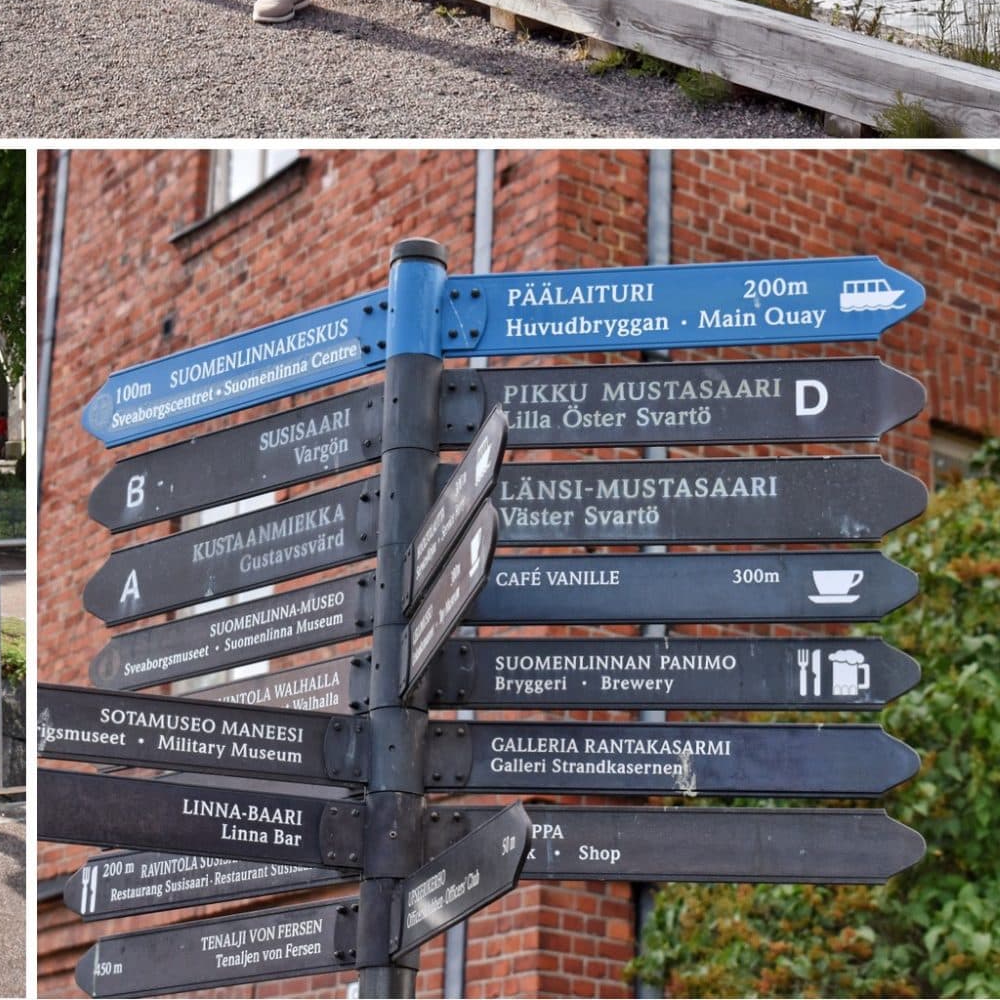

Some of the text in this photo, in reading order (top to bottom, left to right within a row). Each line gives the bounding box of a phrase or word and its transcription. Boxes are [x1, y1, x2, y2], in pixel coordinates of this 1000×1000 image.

[507, 283, 654, 306] PÄÄLAITURI
[743, 279, 809, 299] 200m
[506, 307, 826, 337] Huvudbryggan Main Quay
[170, 318, 349, 388] SUOMENLINNAKESKUS
[112, 344, 357, 428] Sveaborgscentret Suomenlinna Centre
[116, 382, 152, 404] 100m
[504, 378, 782, 404] PIKKU MUSTASAARI
[795, 379, 829, 416] D
[260, 408, 351, 450] SUSISAARI
[505, 405, 711, 429] Lilla Öster Svartö
[295, 439, 348, 465] Vargön
[126, 475, 146, 508] B
[501, 476, 777, 501] LÄNSI-MUSTASAARI
[500, 505, 660, 527] Väster Svartö
[192, 504, 346, 562] KUSTAANMIEKKA
[240, 531, 345, 573] Gustavssvärd
[120, 569, 141, 603] A
[496, 567, 620, 587] CAFÉ VANILLE
[732, 568, 780, 584] 300m
[210, 592, 345, 638] SUOMENLINNA-MUSEO
[124, 614, 344, 676] Sveaborgsmuseet Suomenlinna Museum
[495, 655, 737, 671] SUOMENLINNAN PANIMO
[275, 671, 340, 699] WALHALLA
[495, 675, 674, 693] Bryggeri Brewery
[100, 708, 304, 743] SOTAMUSEO MANEESI
[158, 735, 226, 760] Military
[230, 744, 303, 764] Museum
[491, 738, 731, 757] GALLERIA RANTAKASARMI
[490, 758, 683, 776] Galleri Strandkasernen
[182, 799, 303, 827] LINNA-BAARI
[221, 824, 302, 847] Linna Bar
[531, 824, 564, 840] PPA
[140, 856, 198, 879] RAVINTOLA
[579, 845, 621, 865] Shop
[103, 861, 135, 878] 200 m
[110, 882, 163, 902] Restaurang
[165, 873, 209, 893] Susisaari
[214, 863, 269, 885] Restaurant
[201, 919, 323, 952] TENALJI VON FERSEN
[113, 961, 123, 974] m
[216, 942, 321, 968] Tenaljen von Fersen
